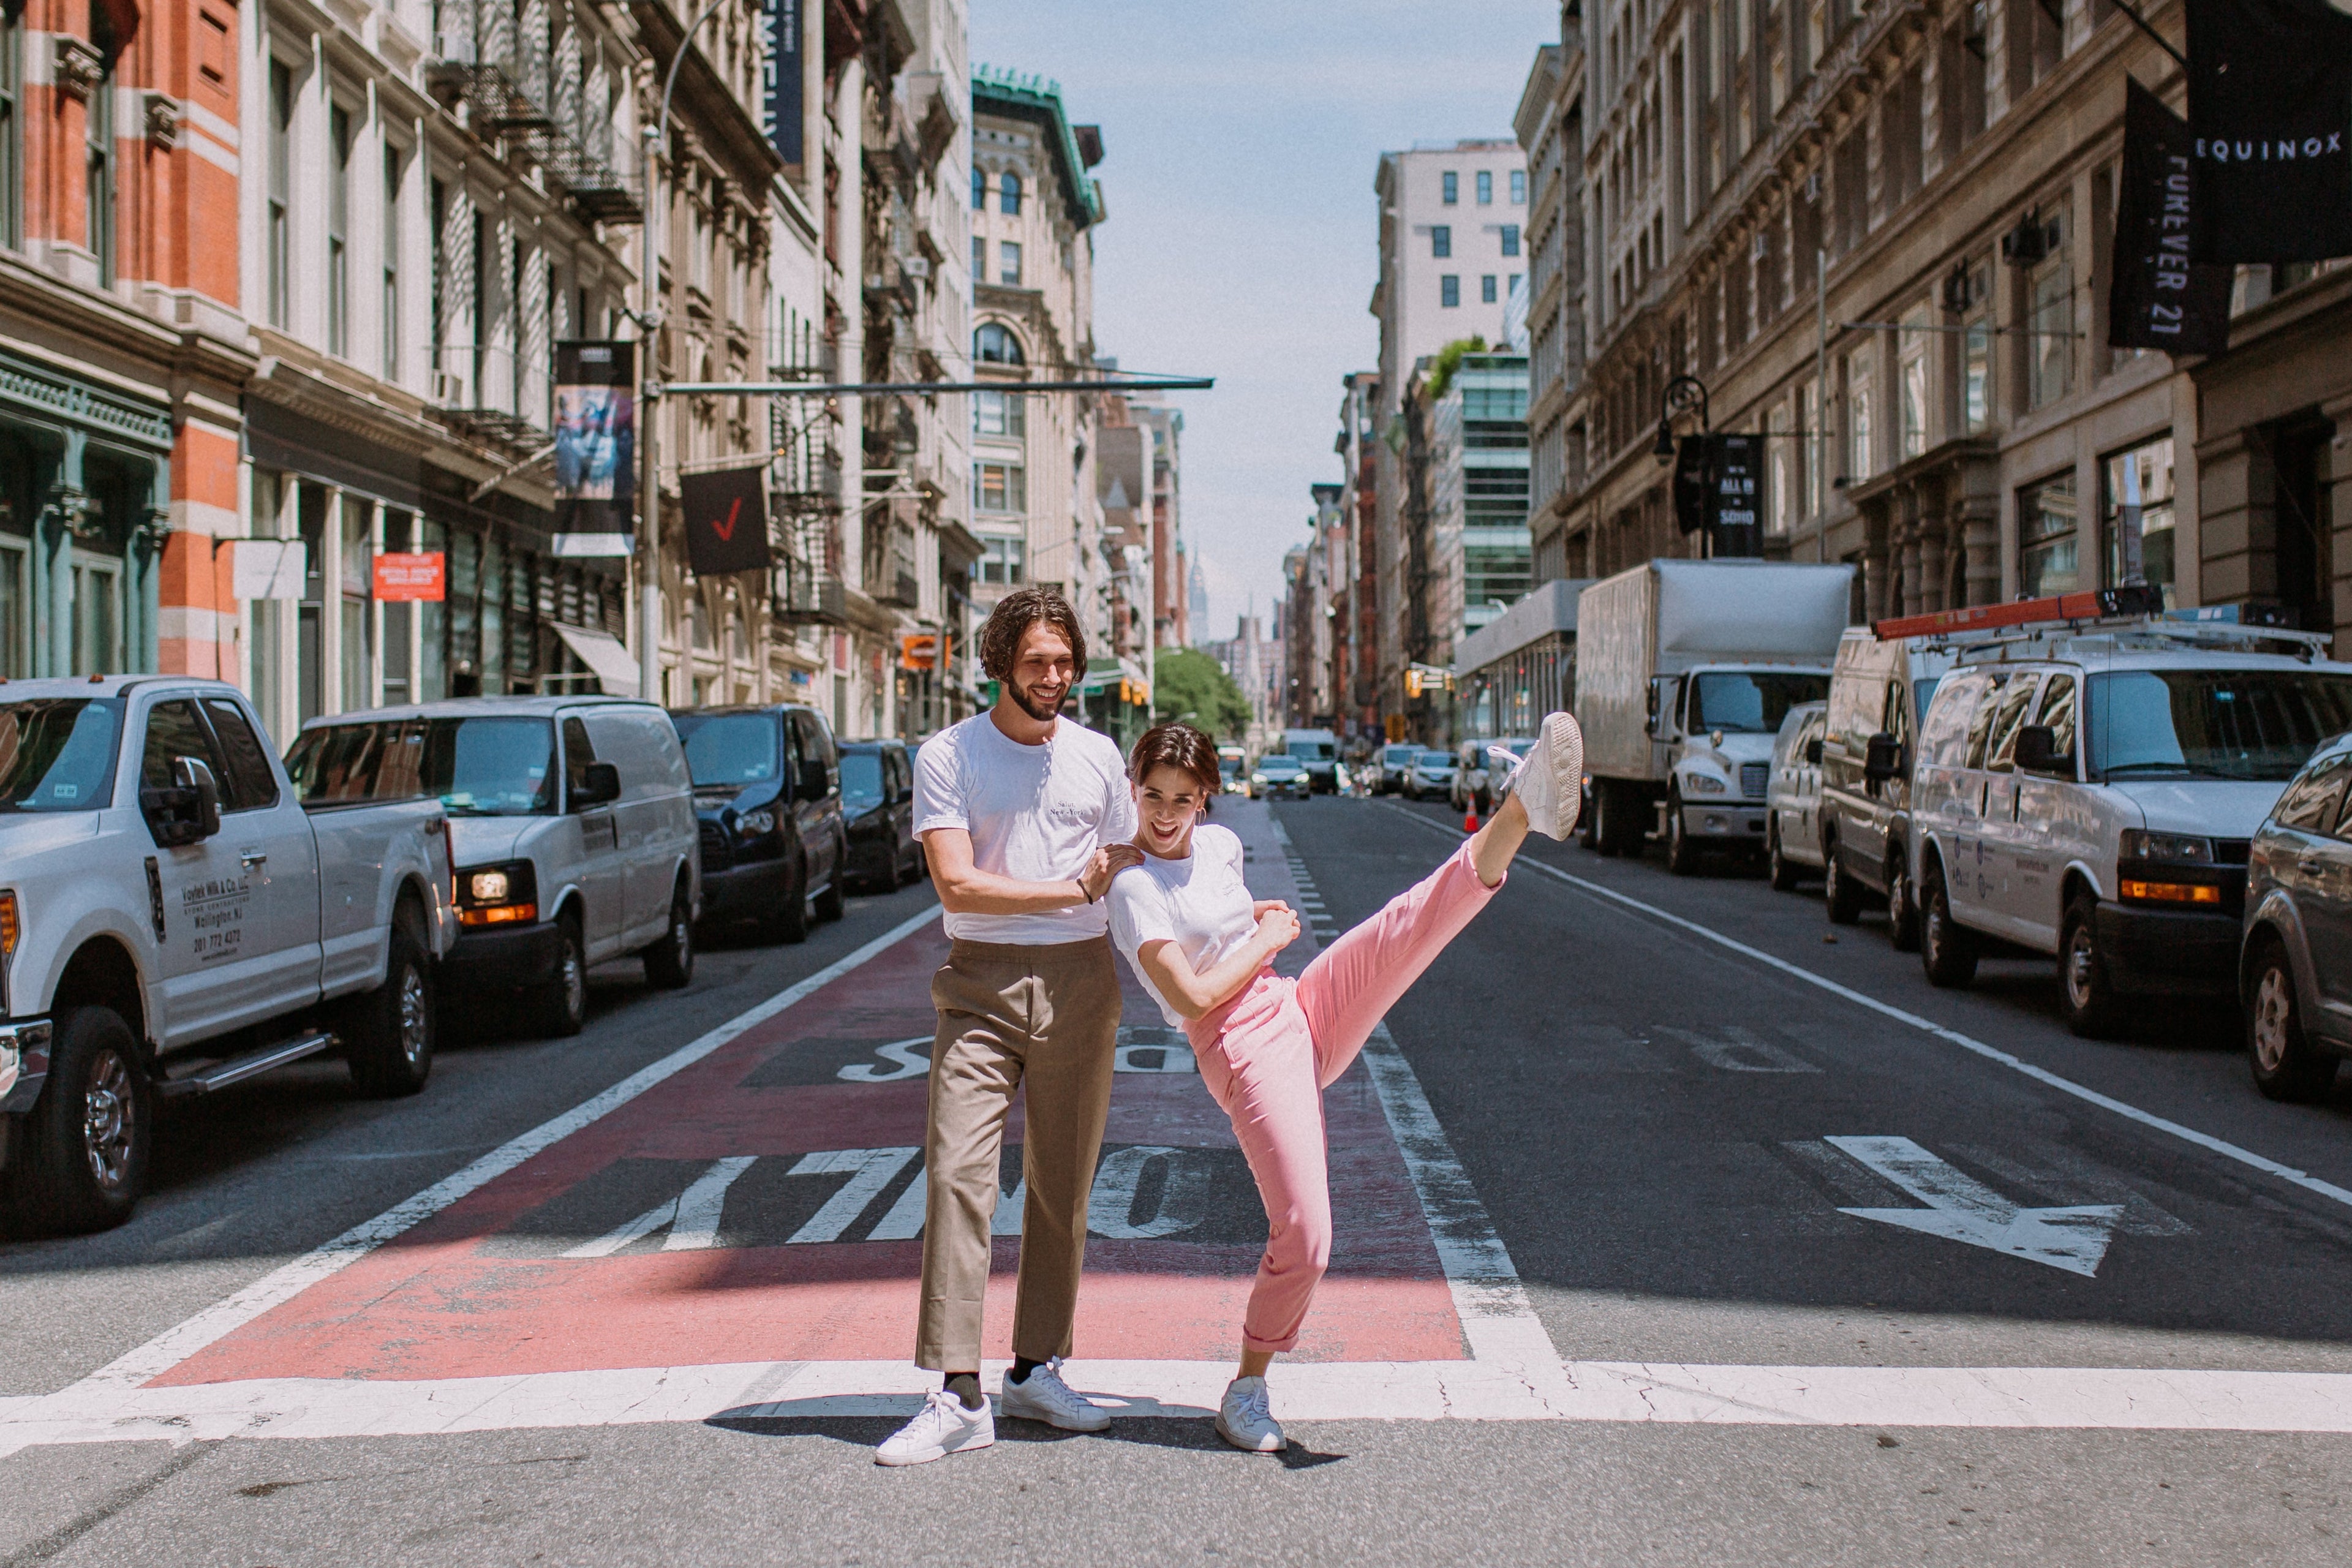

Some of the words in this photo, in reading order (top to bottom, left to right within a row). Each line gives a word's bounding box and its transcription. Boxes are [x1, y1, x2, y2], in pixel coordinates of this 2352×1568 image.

[2195, 130, 2342, 163] EQUINOX
[2150, 303, 2184, 335] 21
[1720, 477, 1742, 494] ALL
[1720, 508, 1755, 525] SOHO
[221, 880, 225, 894] &
[233, 907, 243, 920] NJ
[194, 937, 206, 953] 201
[209, 933, 222, 949] 772
[837, 1026, 1196, 1082] BS
